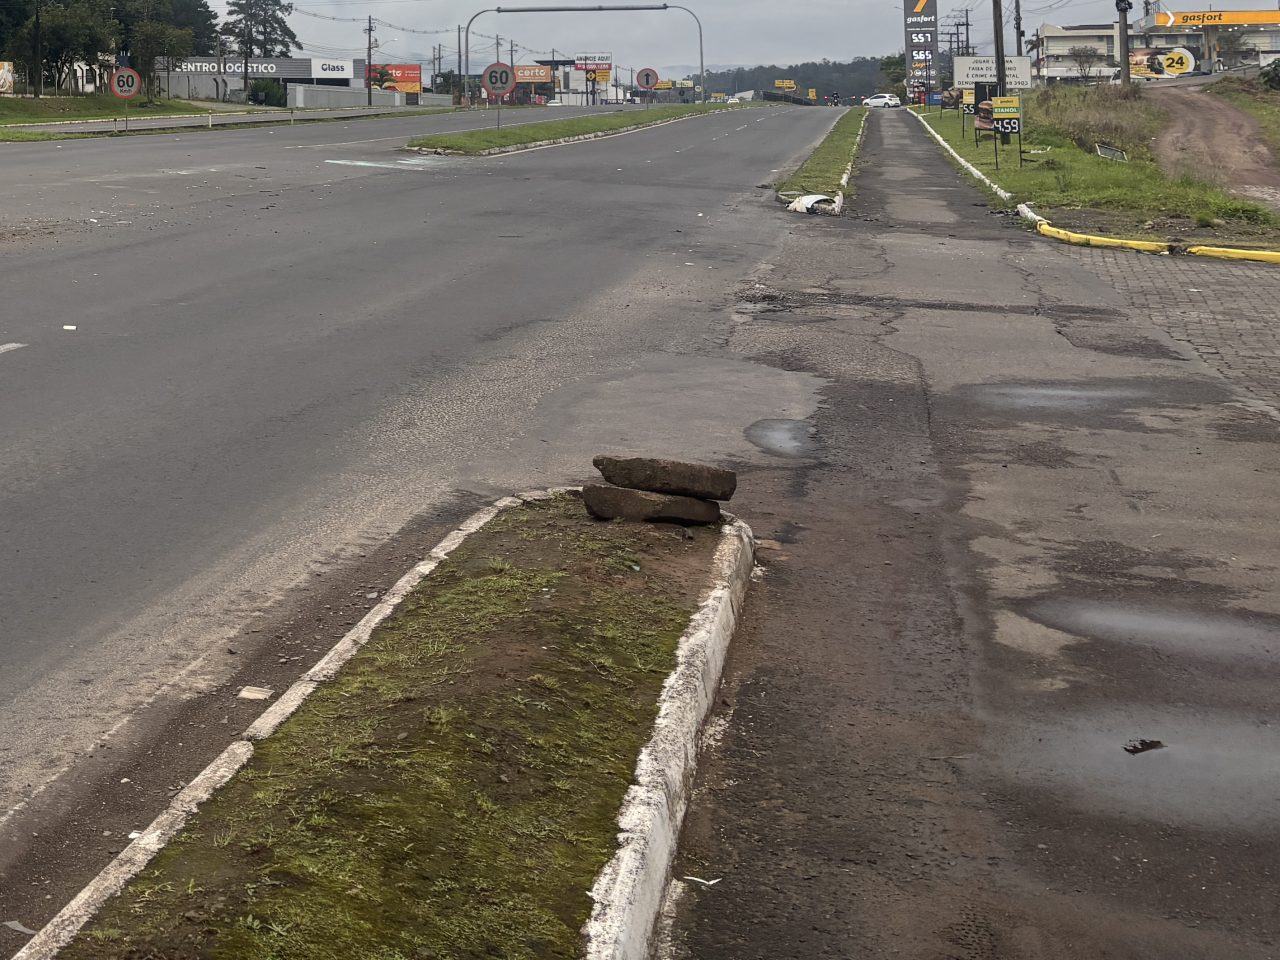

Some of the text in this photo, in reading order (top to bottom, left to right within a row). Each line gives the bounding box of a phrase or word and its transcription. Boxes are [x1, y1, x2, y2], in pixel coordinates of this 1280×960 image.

[906, 15, 935, 24] gasfort
[1181, 13, 1223, 23] gasfort
[220, 60, 276, 73] LOGÍSTICO
[321, 63, 345, 72] Glass
[1166, 56, 1185, 68] 24
[489, 70, 509, 85] 60
[518, 68, 546, 77] certo
[117, 74, 135, 88] 60
[963, 104, 975, 114] 5.5
[994, 119, 1019, 133] 4.59
